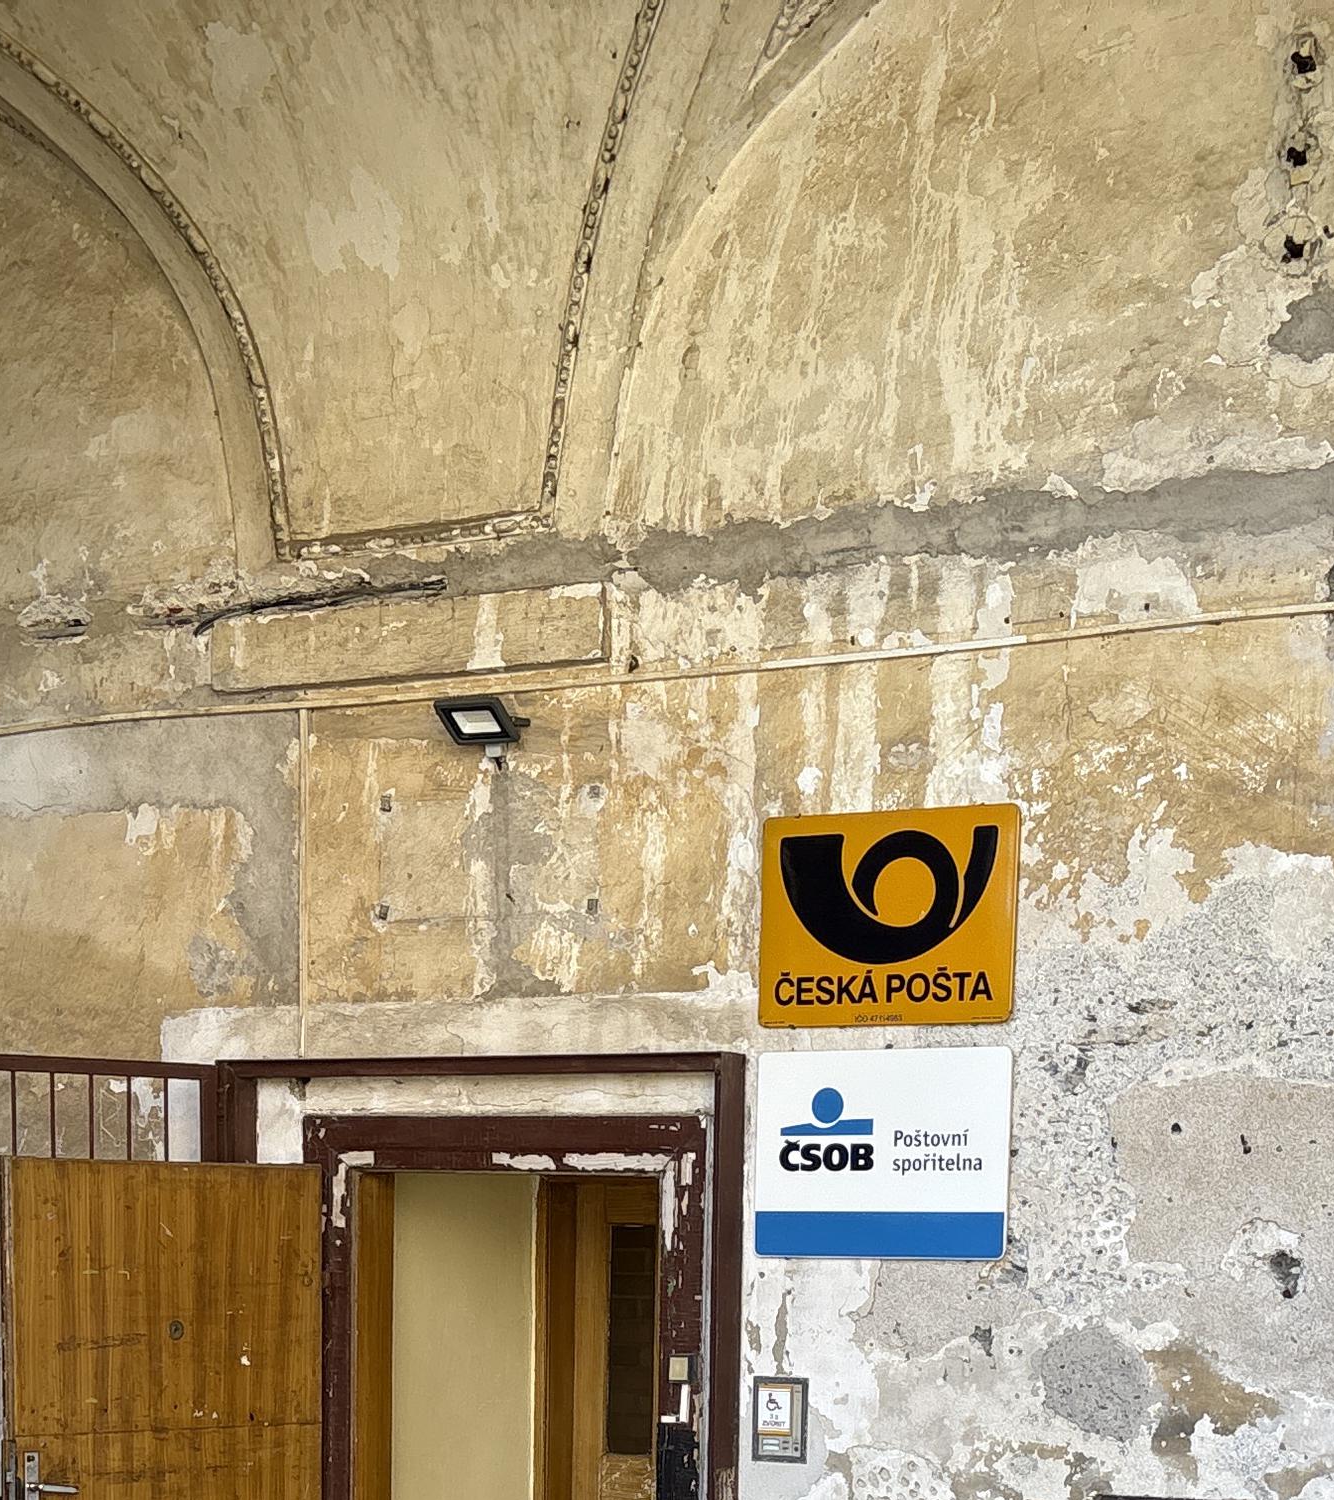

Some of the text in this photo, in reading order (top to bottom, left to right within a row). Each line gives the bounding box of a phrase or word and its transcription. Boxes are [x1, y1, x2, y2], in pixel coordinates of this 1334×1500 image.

[774, 966, 993, 1006] ČESKÁ POŠTA
[893, 1128, 969, 1147] Poštovní
[779, 1139, 874, 1172] ČSOB
[892, 1153, 983, 1176] spořitelna
